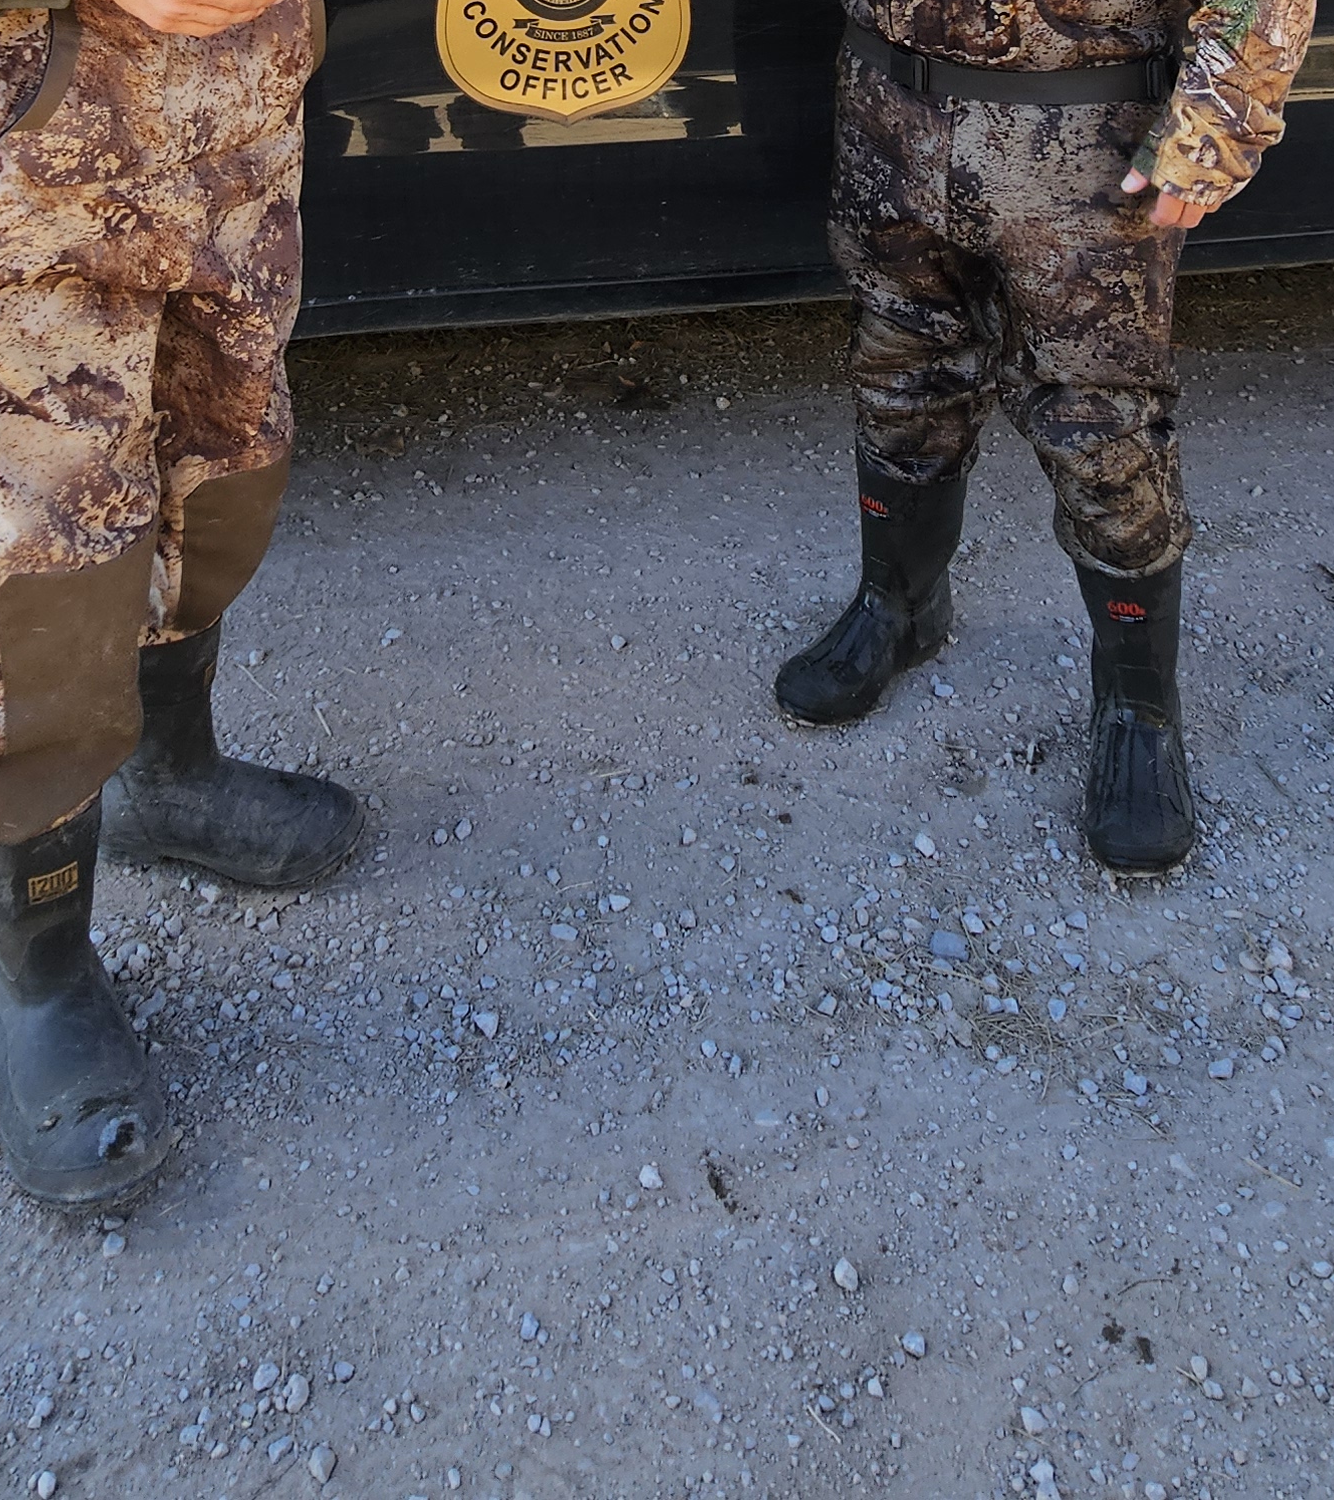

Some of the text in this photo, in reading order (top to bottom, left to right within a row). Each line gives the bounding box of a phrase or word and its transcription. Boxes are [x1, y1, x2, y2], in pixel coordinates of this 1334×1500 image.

[533, 27, 594, 41] SINCE 1887
[500, 62, 634, 100] OFFICER
